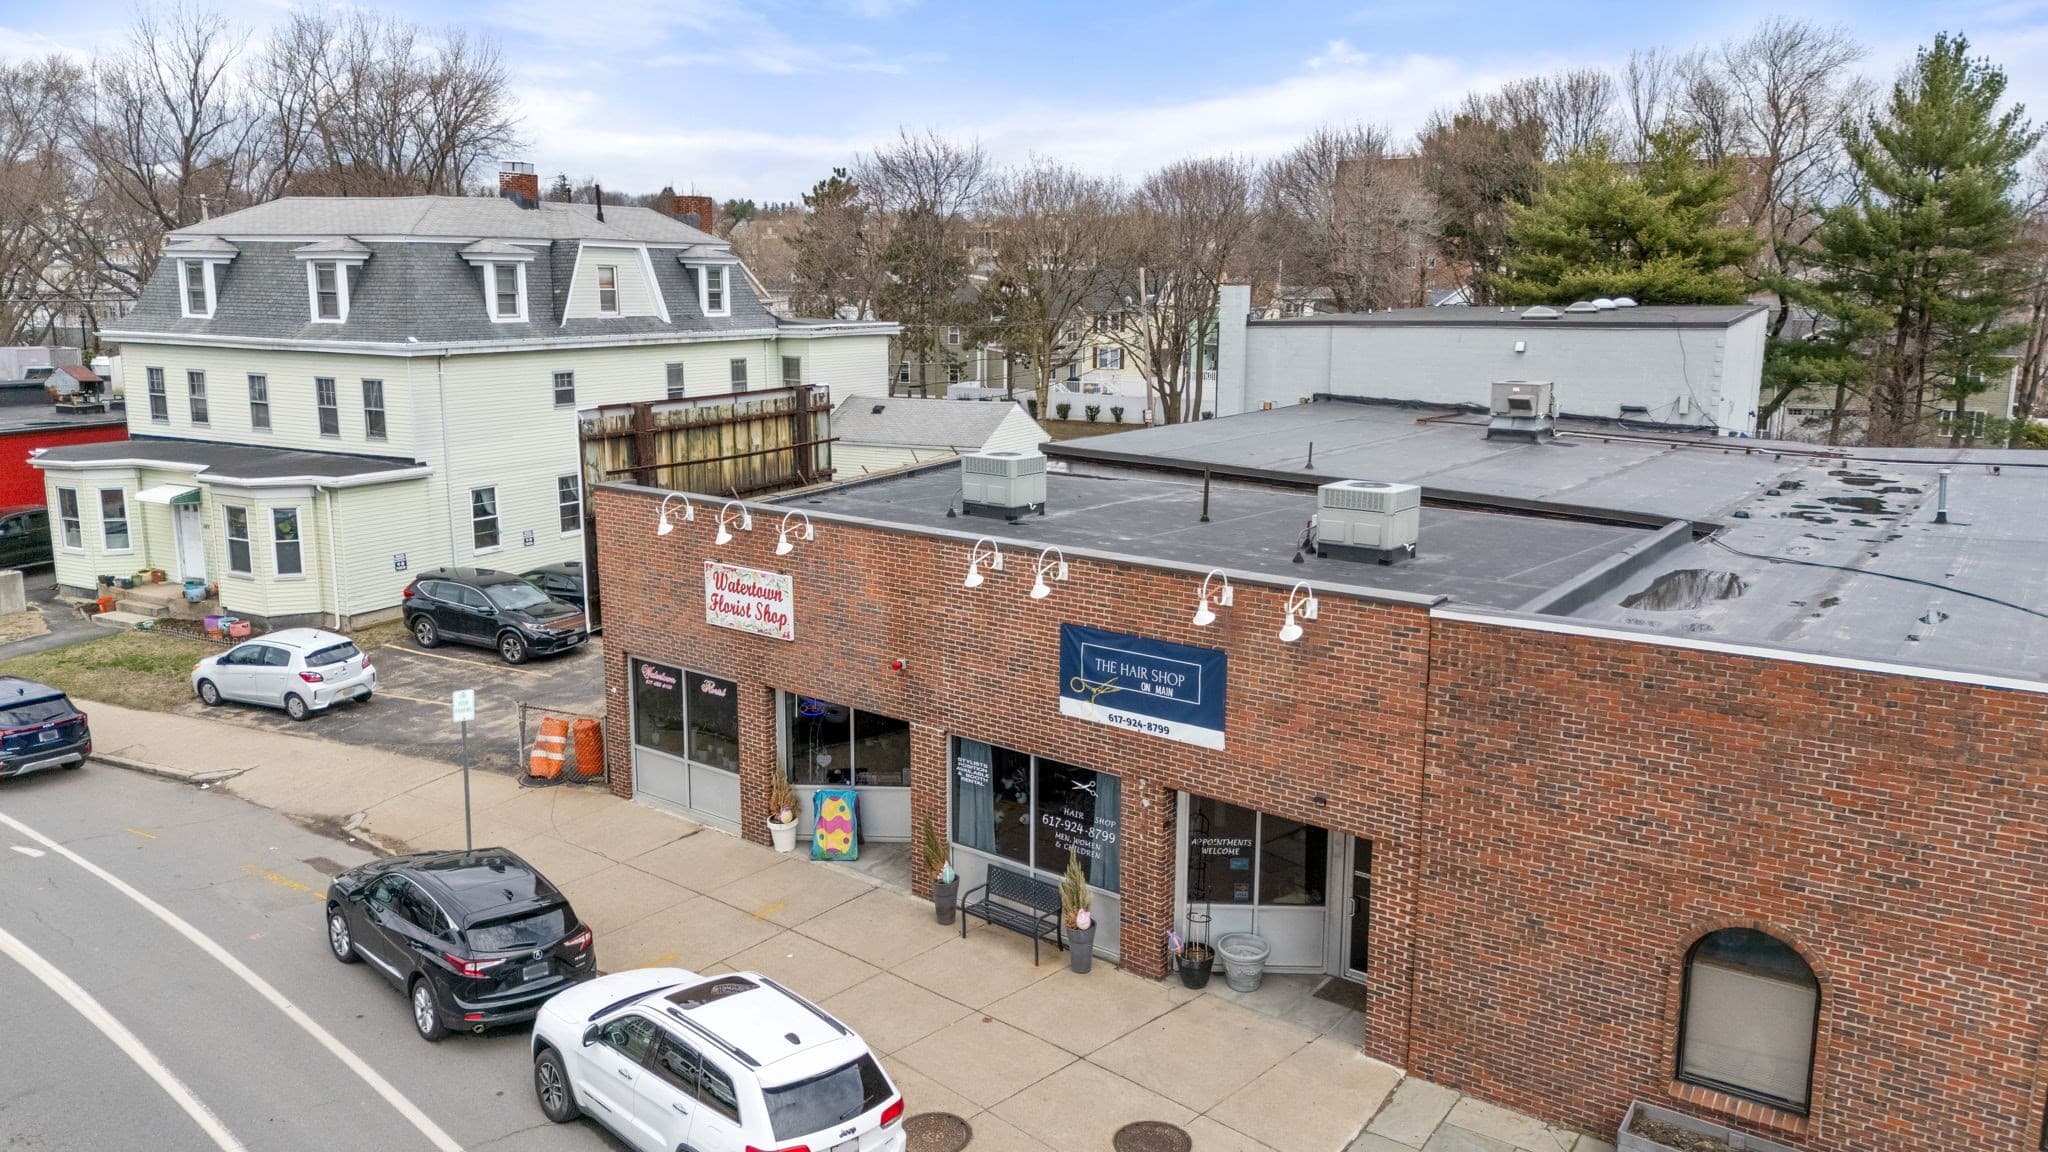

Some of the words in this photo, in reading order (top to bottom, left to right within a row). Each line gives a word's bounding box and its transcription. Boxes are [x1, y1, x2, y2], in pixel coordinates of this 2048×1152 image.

[713, 571, 783, 602] Watertown
[710, 593, 751, 618] Florist
[755, 602, 787, 631] Shop
[1095, 658, 1117, 674] THE
[1120, 663, 1148, 681] HAIR
[1151, 669, 1185, 688] SHOP
[1140, 682, 1151, 692] ON
[1155, 685, 1174, 697] MAIN
[1108, 713, 1170, 735] 617-924-8799
[1063, 808, 1084, 819] HAIR
[1094, 817, 1117, 828] SHOP
[1042, 814, 1116, 843] 617-924-8799
[1055, 832, 1071, 843] MEN,
[1074, 837, 1101, 850] WOMEN
[1191, 839, 1253, 847] APPOINTMENTS
[1201, 847, 1240, 855] WELCOME
[1063, 844, 1100, 859] CHILDREN
